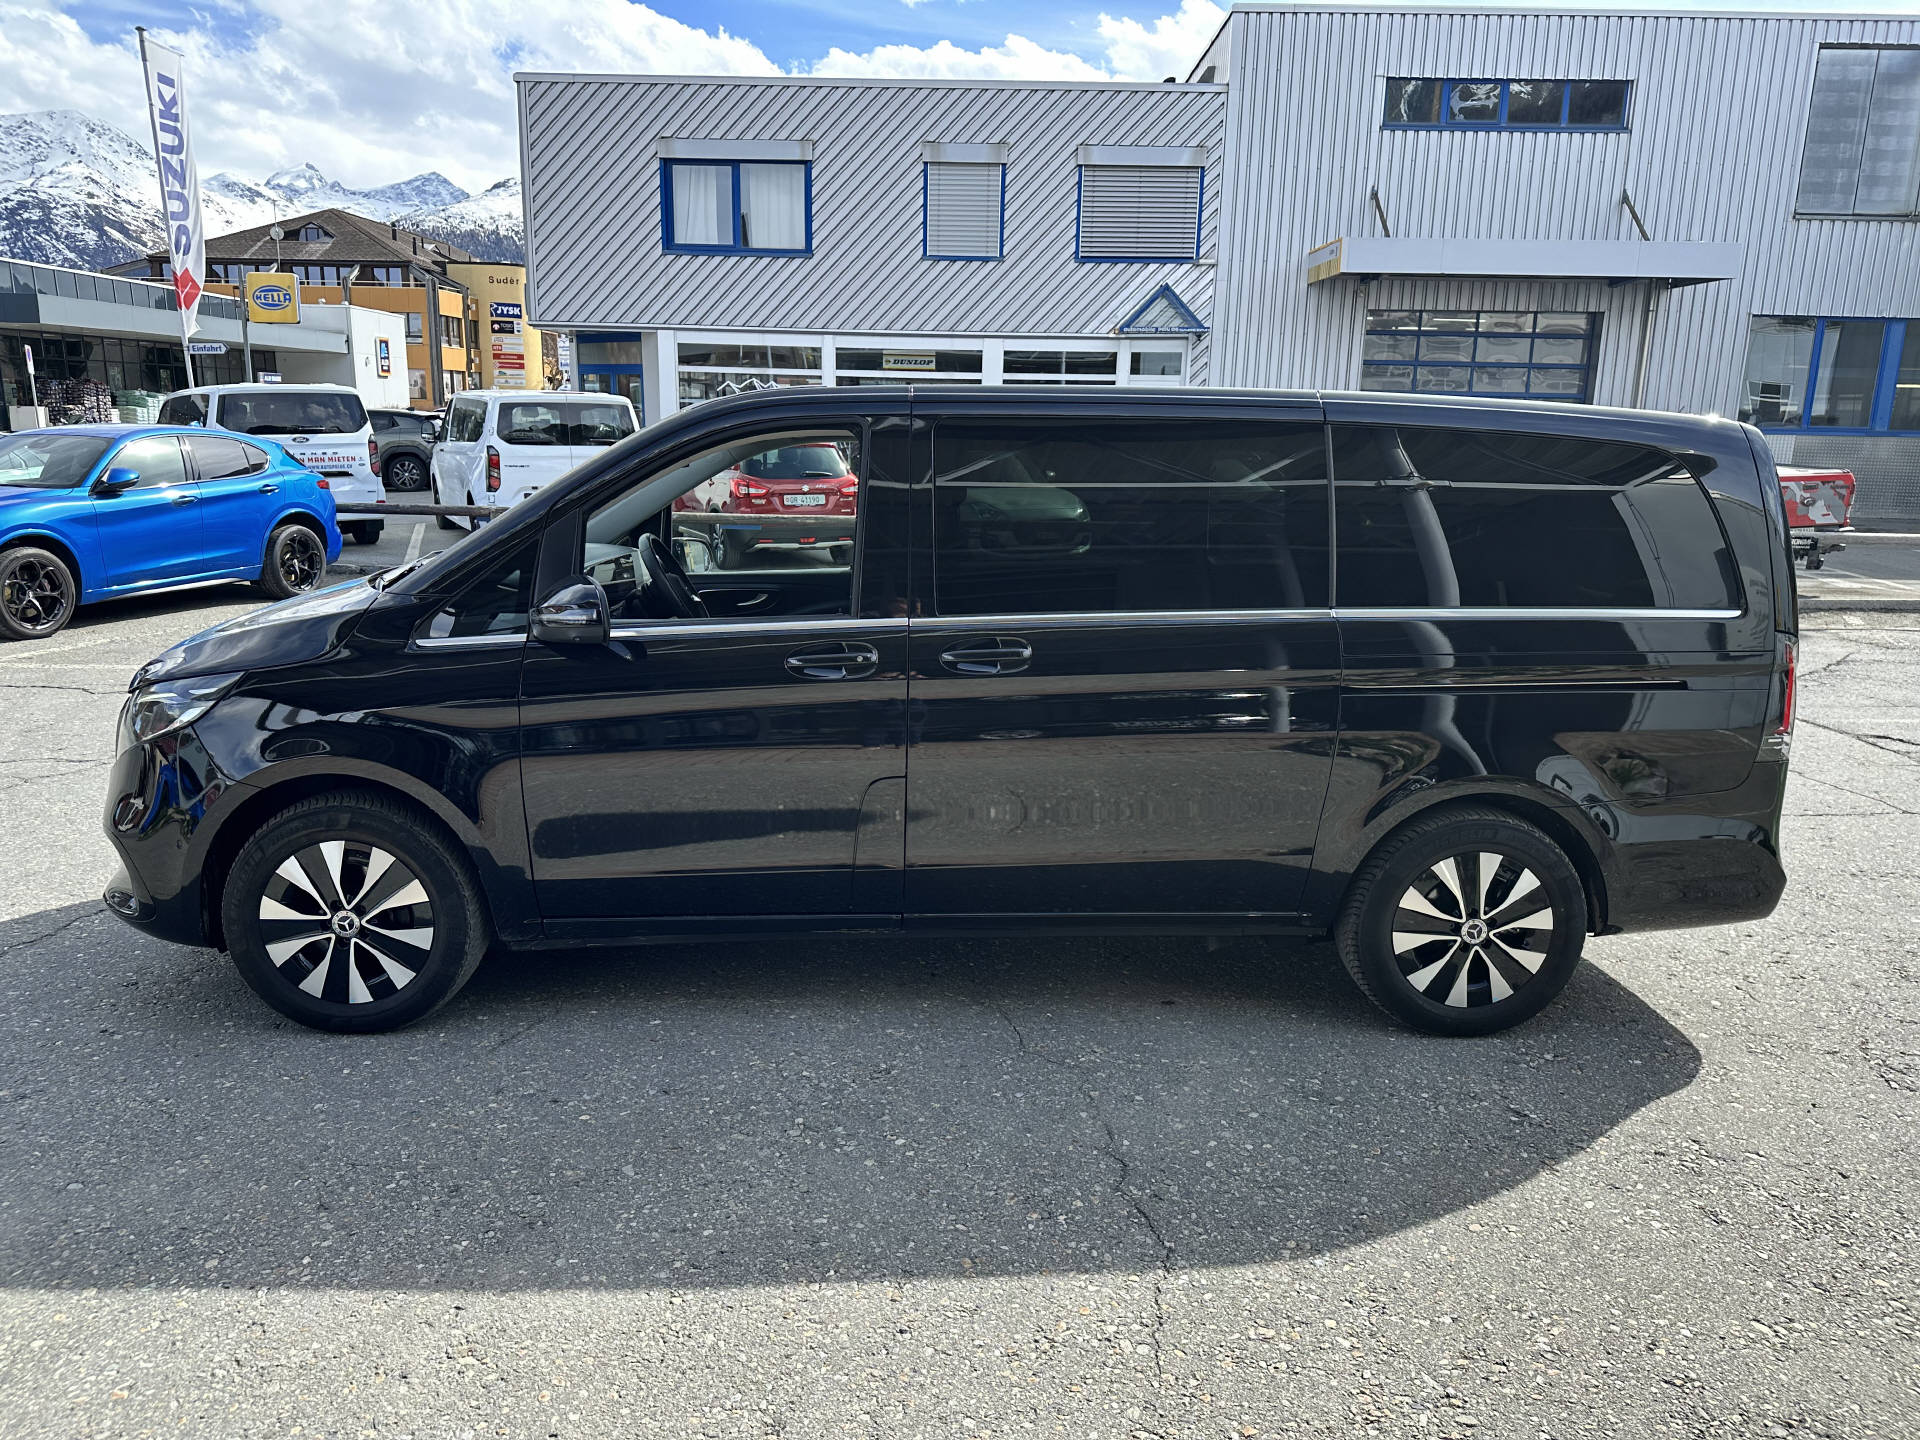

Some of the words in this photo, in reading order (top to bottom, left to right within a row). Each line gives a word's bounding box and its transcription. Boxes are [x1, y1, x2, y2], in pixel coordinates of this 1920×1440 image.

[157, 72, 191, 257] SUZUKI
[255, 292, 292, 303] HELLA
[496, 306, 521, 315] JYSK
[191, 344, 223, 353] Einfahrt
